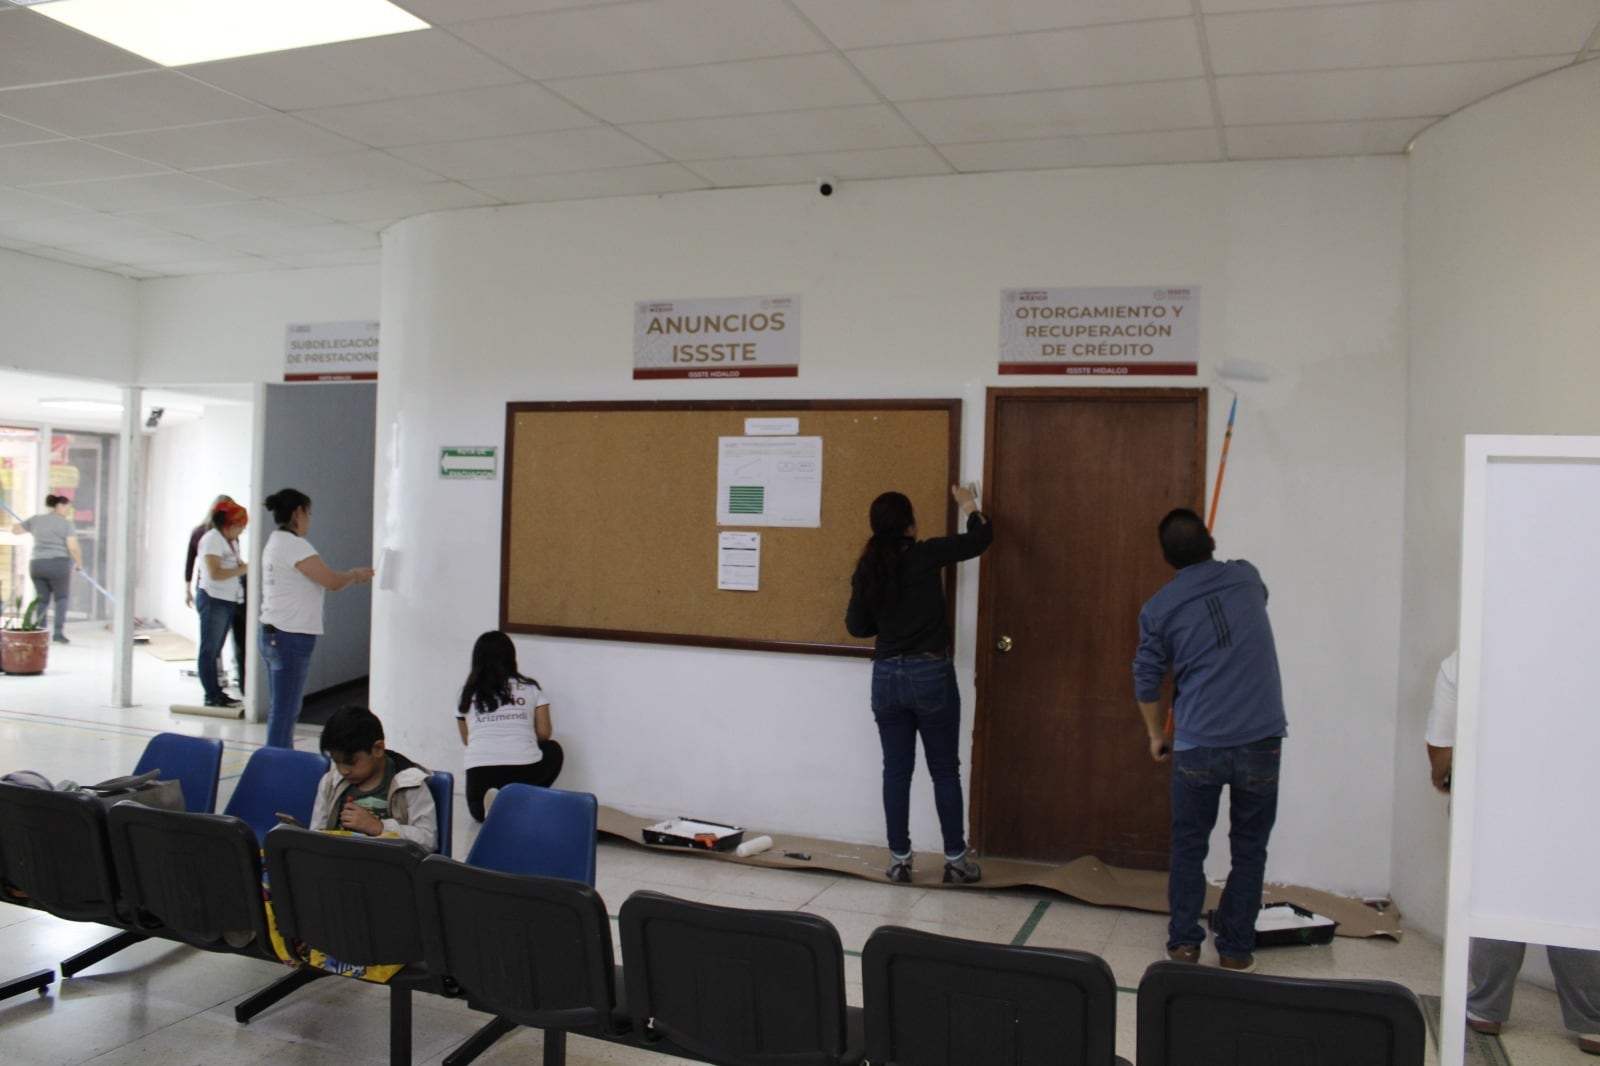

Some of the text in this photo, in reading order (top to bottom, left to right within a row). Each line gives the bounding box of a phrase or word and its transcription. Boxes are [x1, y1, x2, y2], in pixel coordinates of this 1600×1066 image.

[1015, 305, 1184, 320] OTORGAMIENTO Y
[647, 312, 786, 335] ANUNCIOS
[1025, 321, 1172, 338] RECUPERACIÓN
[673, 342, 757, 363] ISSSTE
[1041, 340, 1154, 357] DE CRÉDITO
[287, 351, 378, 364] DE PRESTACIONE
[475, 712, 528, 723] Arizmendi
